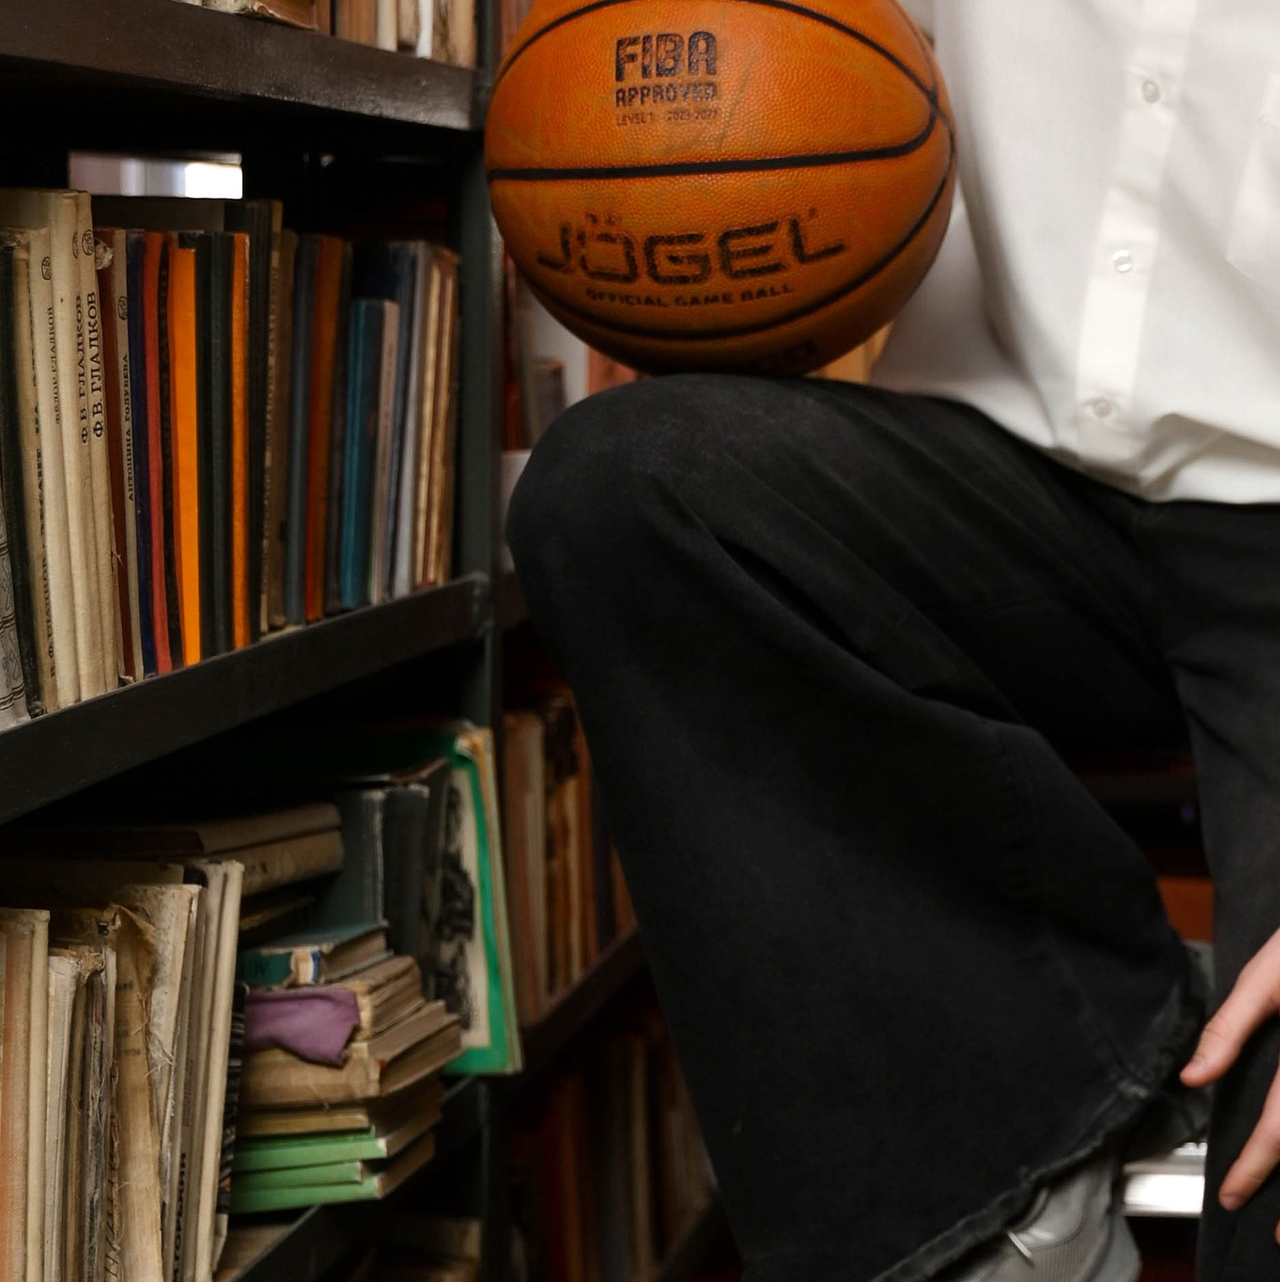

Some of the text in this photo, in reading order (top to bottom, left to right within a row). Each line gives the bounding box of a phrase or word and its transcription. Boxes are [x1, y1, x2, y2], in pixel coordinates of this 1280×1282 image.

[615, 31, 717, 82] FIBA
[615, 83, 718, 108] APPROVED
[537, 213, 845, 284] JÖGEL
[584, 283, 793, 308] OFFICIAL GAME BALL
[75, 295, 87, 399] ГЛАДКОВ
[86, 292, 105, 439] Ф. В. ГЛАДКОВ
[122, 353, 134, 502] АНТОНИНА ГОЛУБЕВА
